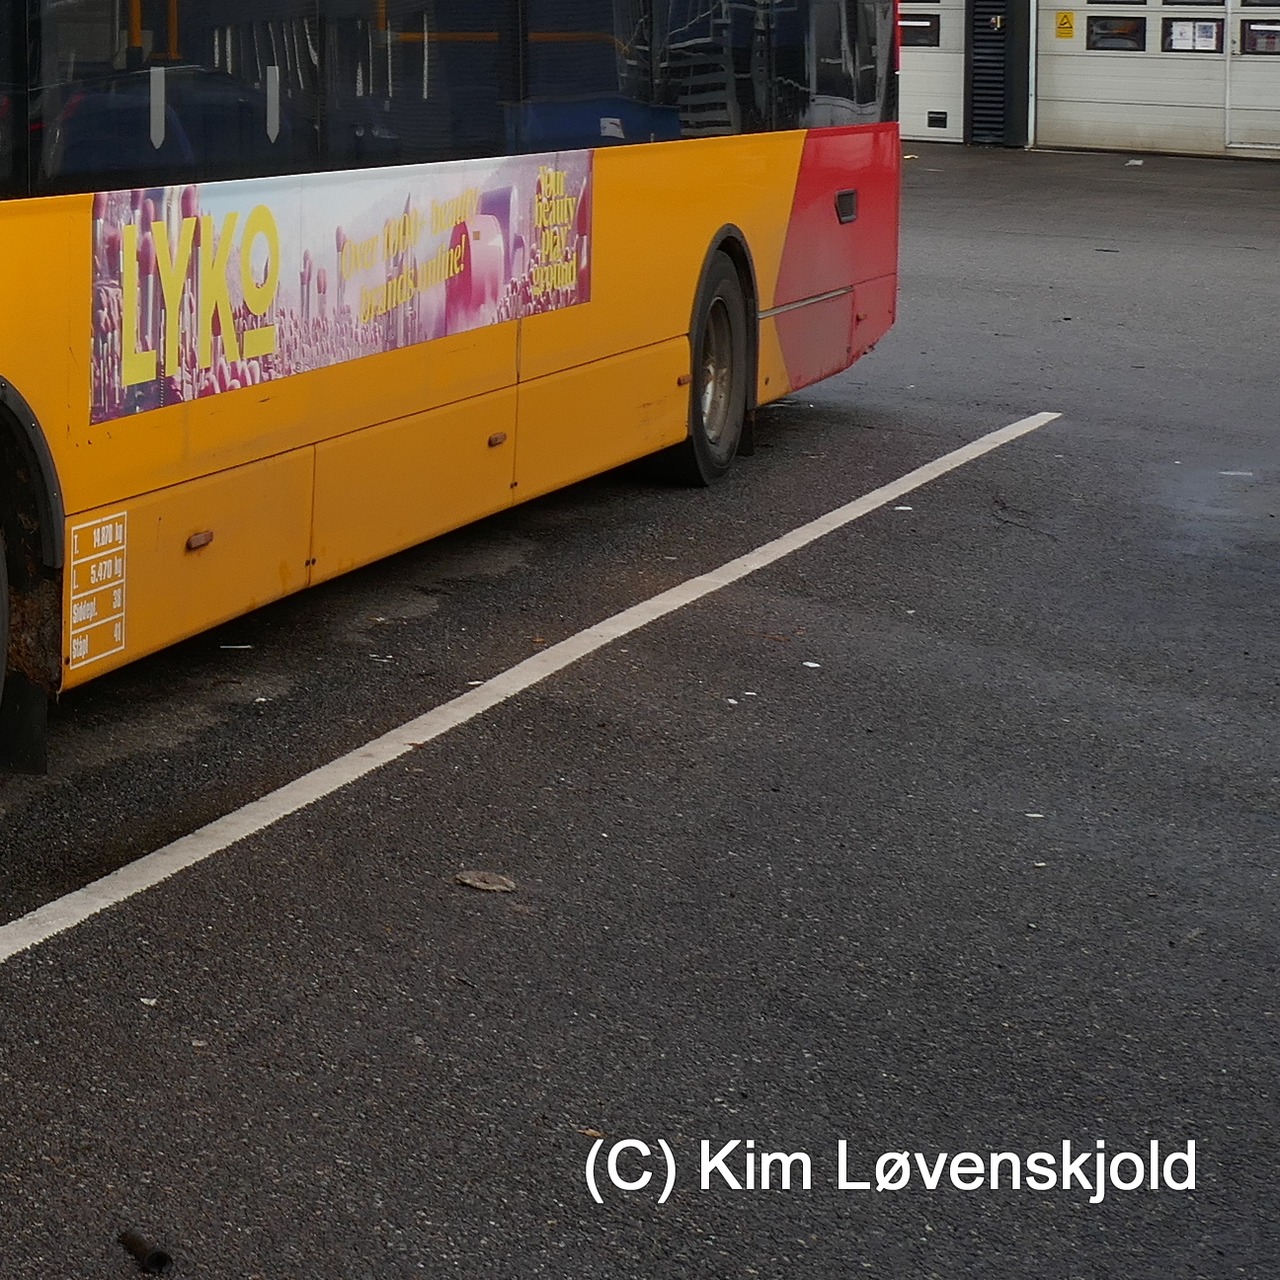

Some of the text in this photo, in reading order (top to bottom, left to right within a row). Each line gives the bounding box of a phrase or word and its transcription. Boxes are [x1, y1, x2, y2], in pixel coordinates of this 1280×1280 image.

[539, 166, 568, 197] Your
[534, 195, 577, 229] beauty
[341, 235, 380, 280] Over
[431, 187, 481, 236] beauty
[540, 226, 571, 262] play
[359, 234, 467, 324] brands online!
[531, 253, 577, 296] ground
[122, 204, 281, 387] LYKO
[115, 522, 123, 544] kg
[90, 559, 113, 584] 5.470
[114, 556, 122, 578] kg
